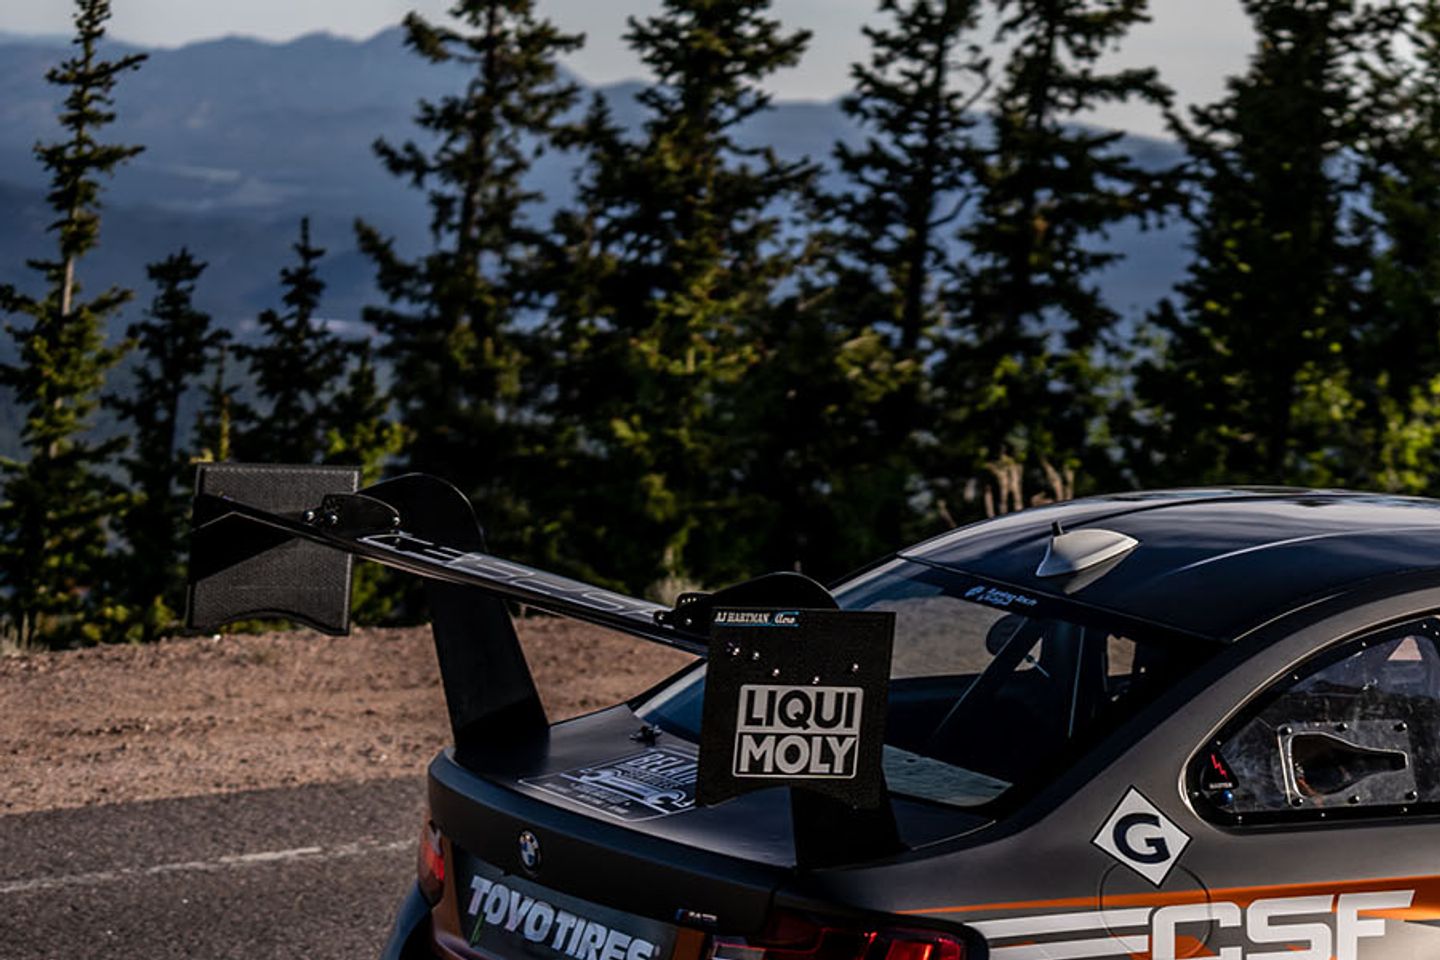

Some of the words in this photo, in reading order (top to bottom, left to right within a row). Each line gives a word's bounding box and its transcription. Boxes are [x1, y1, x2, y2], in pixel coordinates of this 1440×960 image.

[727, 611, 771, 624] HARTMAN
[744, 689, 856, 730] LIQUI
[738, 734, 857, 774] MOLY
[1112, 812, 1172, 865] G
